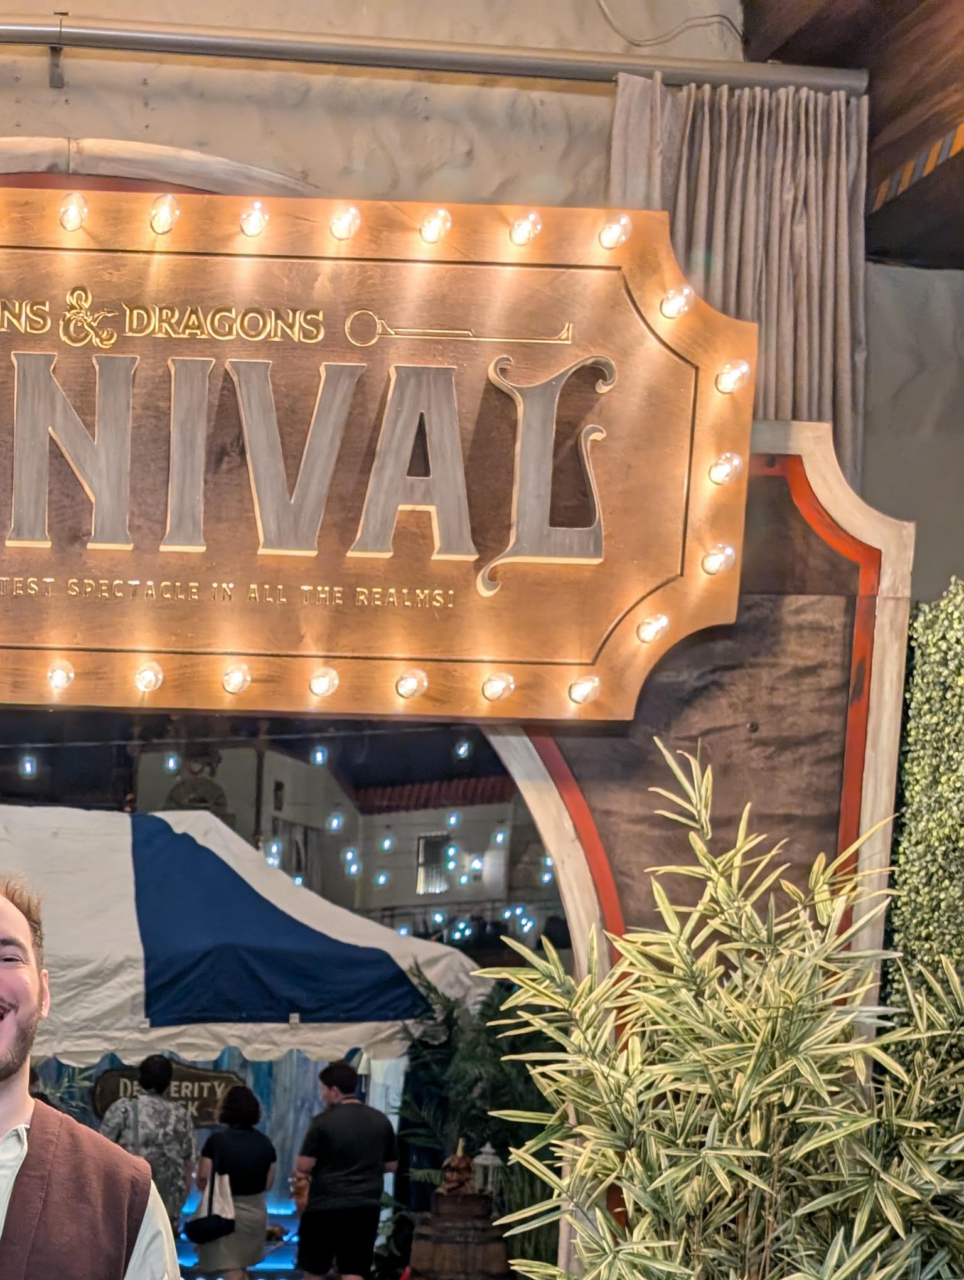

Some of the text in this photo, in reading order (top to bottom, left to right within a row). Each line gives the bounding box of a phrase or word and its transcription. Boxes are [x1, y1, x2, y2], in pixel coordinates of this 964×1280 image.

[121, 302, 326, 344] DRAGONS
[67, 578, 200, 600] SPECTACLE
[211, 582, 235, 601] IN
[246, 584, 288, 604] ALL
[300, 585, 344, 605] THE
[119, 1078, 226, 1099] DEERITY
